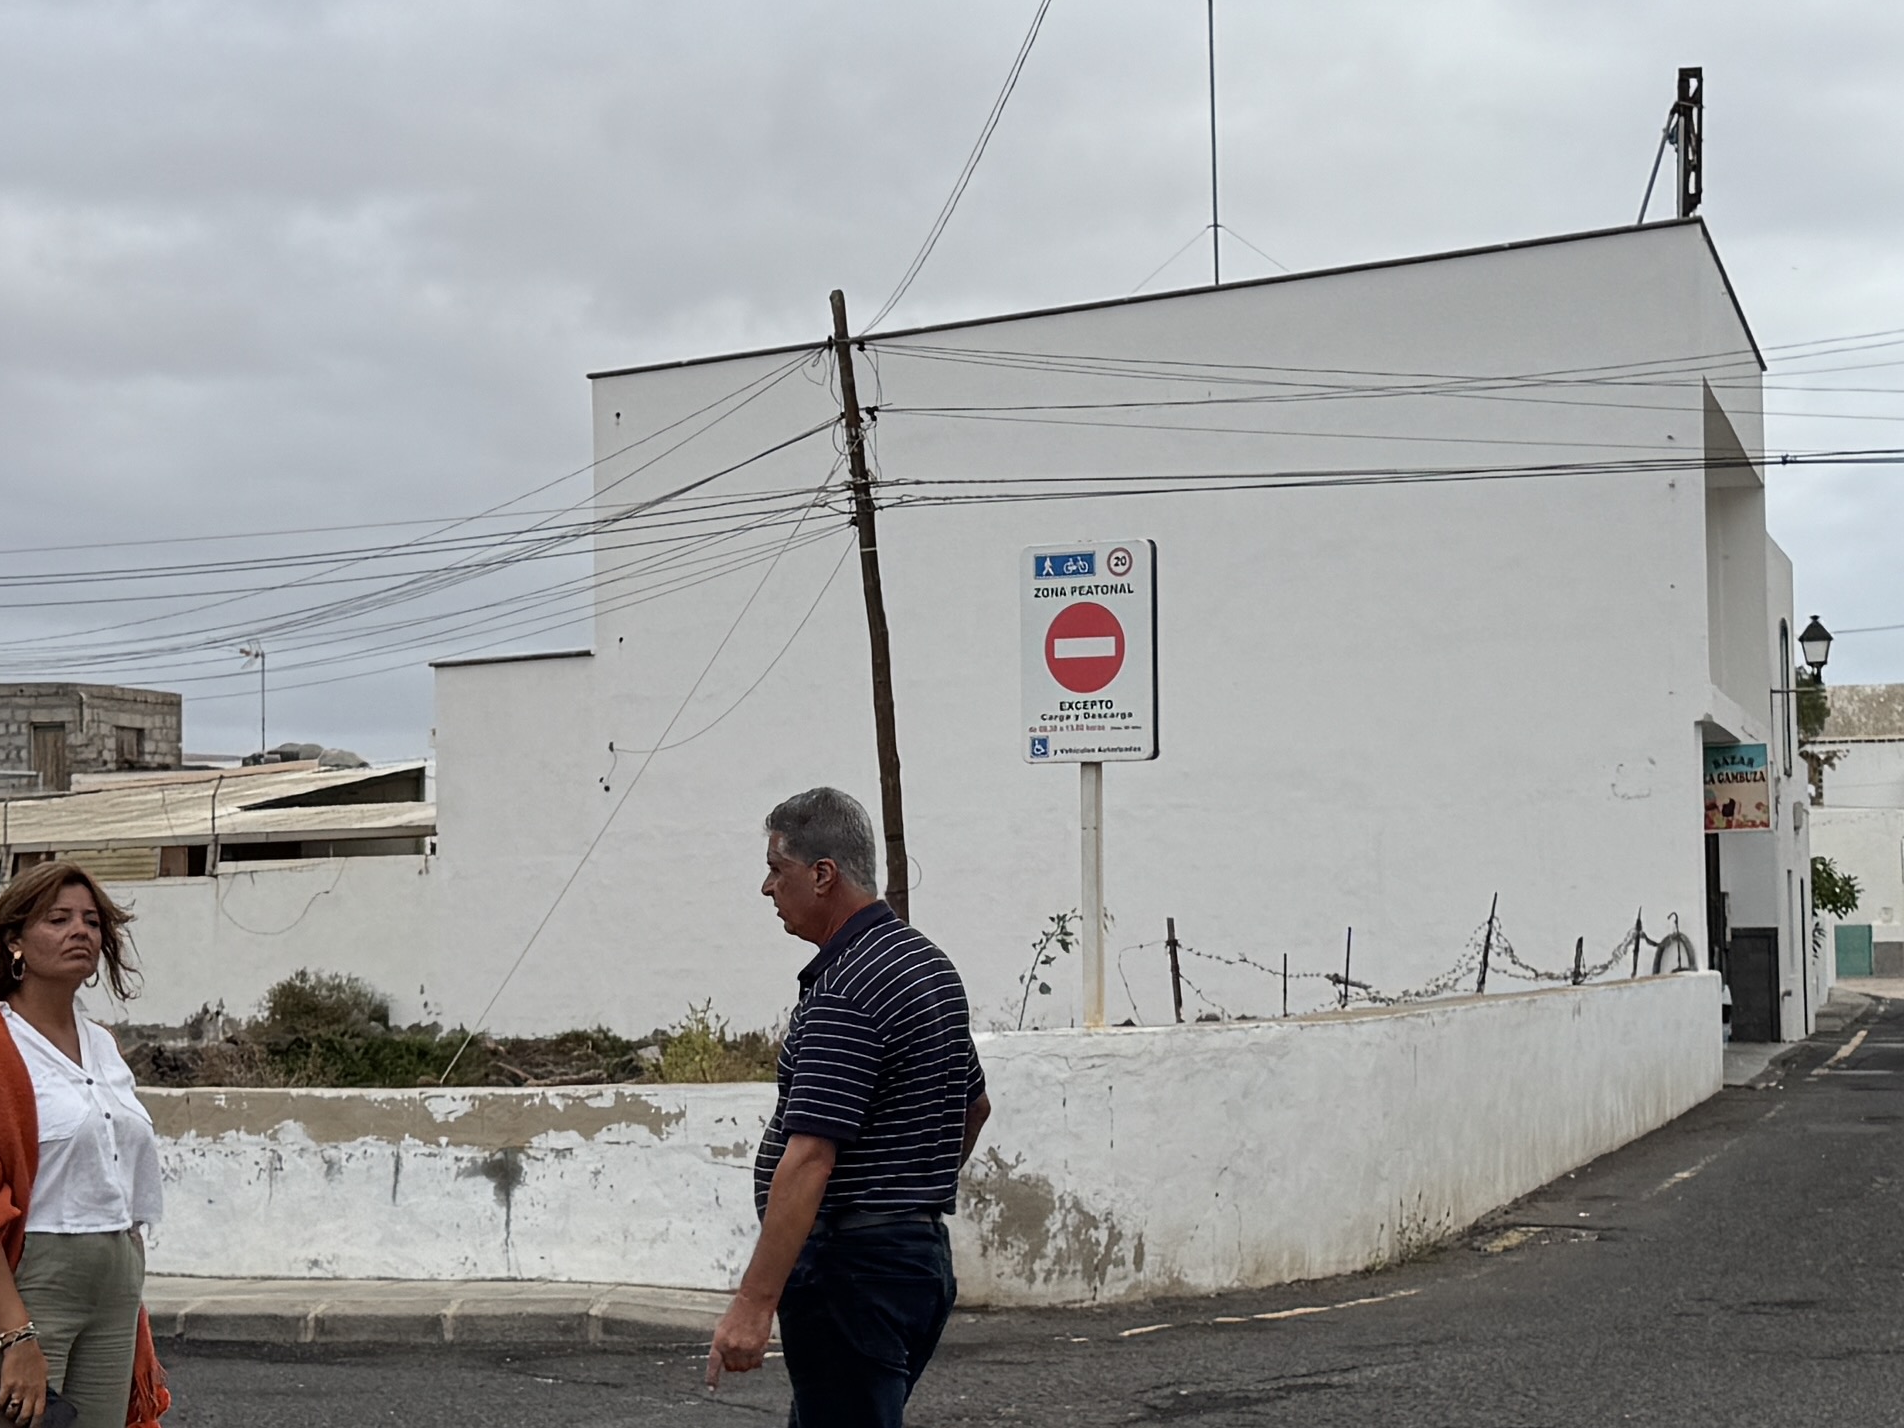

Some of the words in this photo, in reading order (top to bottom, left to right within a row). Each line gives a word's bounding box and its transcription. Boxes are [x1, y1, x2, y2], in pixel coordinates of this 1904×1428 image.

[1113, 556, 1127, 567] 20
[1033, 586, 1067, 598] ZONA
[1071, 583, 1134, 597] PEATONAL
[1059, 699, 1113, 711] EXCEPTO
[1074, 713, 1080, 721] y
[1083, 712, 1133, 720] Descarga
[1712, 755, 1755, 770] BAZAR
[1717, 770, 1766, 784] GAMBUZA
